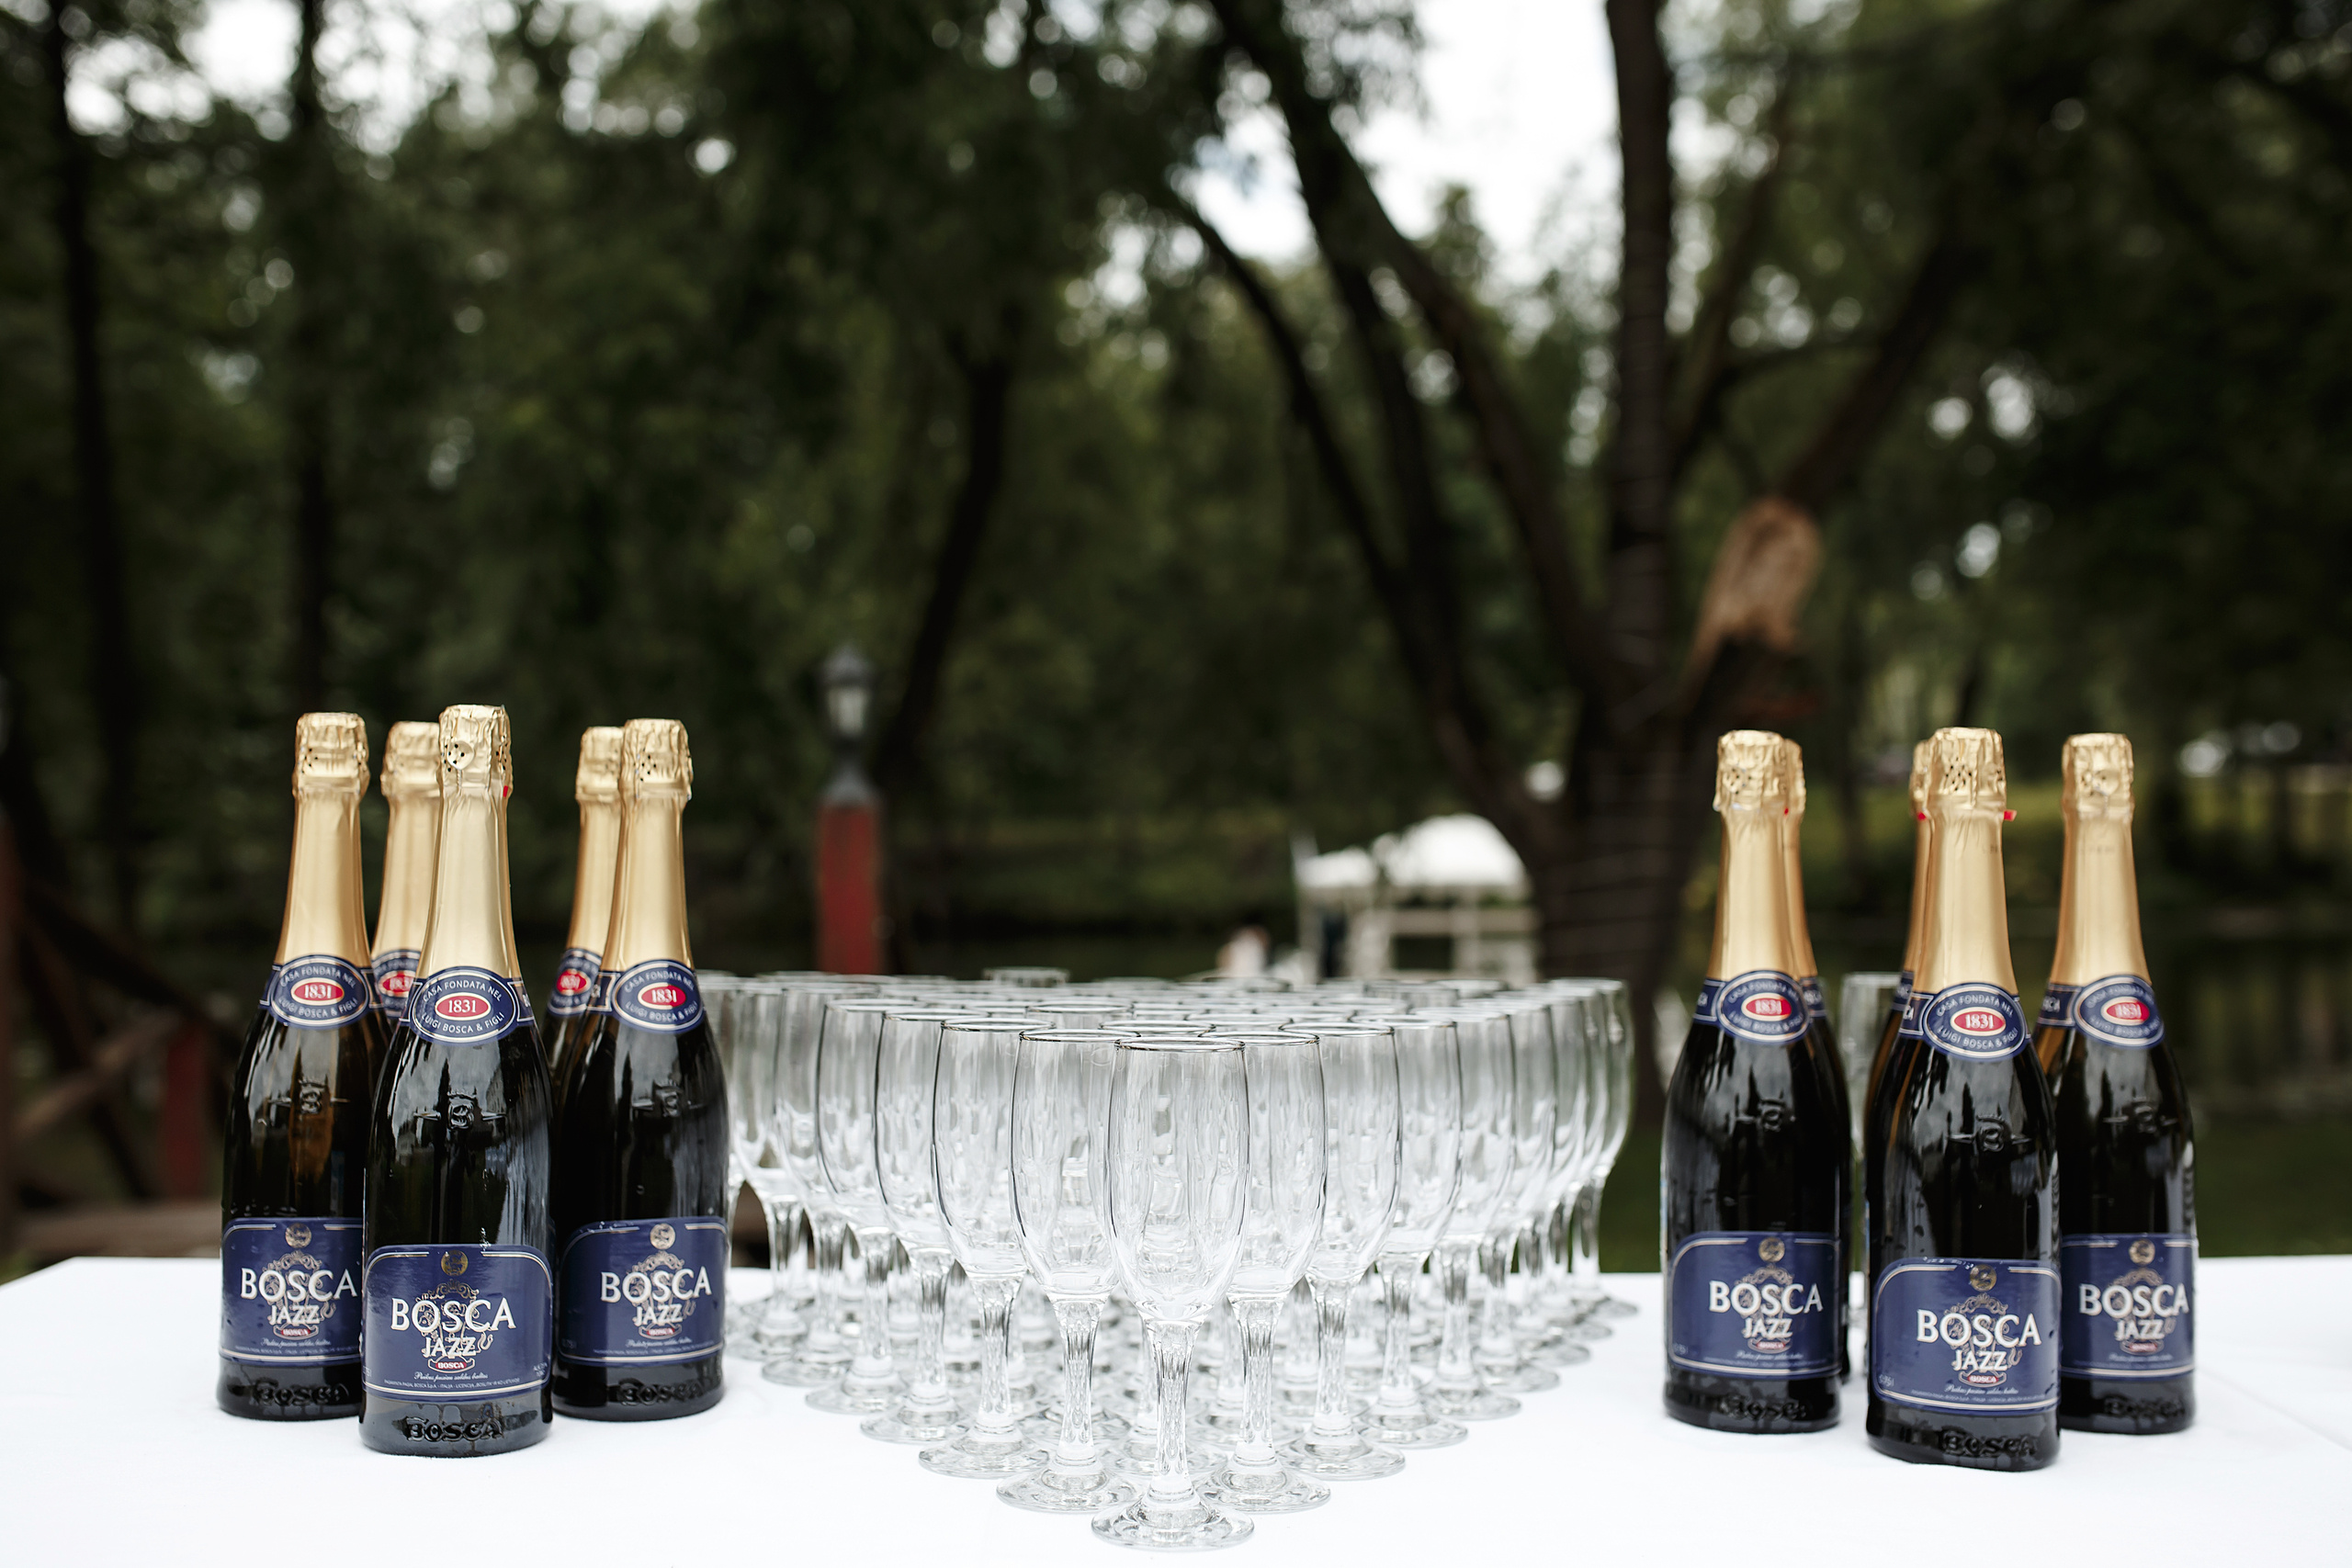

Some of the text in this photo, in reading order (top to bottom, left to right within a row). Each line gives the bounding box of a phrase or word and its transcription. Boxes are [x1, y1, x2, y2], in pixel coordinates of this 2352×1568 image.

[280, 970, 299, 987] CASA
[301, 965, 341, 978] FONDATA
[624, 976, 645, 993] CASA
[645, 970, 682, 981] FONDATA
[304, 985, 331, 998] 1831
[423, 980, 503, 1002] CASA FONDATA NEL
[651, 988, 677, 1003] 1831
[298, 1007, 328, 1019] BOSCA
[448, 999, 476, 1012] 1831
[649, 1010, 677, 1022] BOSCA
[1755, 999, 1782, 1014] 1831
[1936, 998, 1959, 1017] CASA
[1959, 994, 2000, 1006] FONDATA
[421, 1012, 441, 1030] LUIGI
[443, 1024, 474, 1033] BOSCA
[485, 1012, 504, 1029] FIGLI
[1965, 1014, 1994, 1029] 1831
[1937, 1025, 1961, 1043] LUIGI
[1963, 1038, 1994, 1049] BOSCA
[240, 1268, 358, 1303] BOSCA
[600, 1266, 712, 1303] BOSCA
[1708, 1280, 1824, 1315] BOSCA
[2079, 1282, 2189, 1318] BOSCA
[269, 1304, 320, 1325] JAZZ
[390, 1297, 516, 1333] BOSCA
[634, 1303, 684, 1326] JAZZ
[1743, 1317, 1793, 1338] JAZZ
[1917, 1309, 2042, 1348] BOSCA
[2115, 1319, 2165, 1341] JAZZ
[423, 1337, 477, 1359] JAZZ
[437, 1361, 465, 1370] BOSCA
[1953, 1349, 2007, 1371] JAZZ
[1969, 1375, 1997, 1383] BOSCA
[406, 1416, 503, 1442] BOSCA
